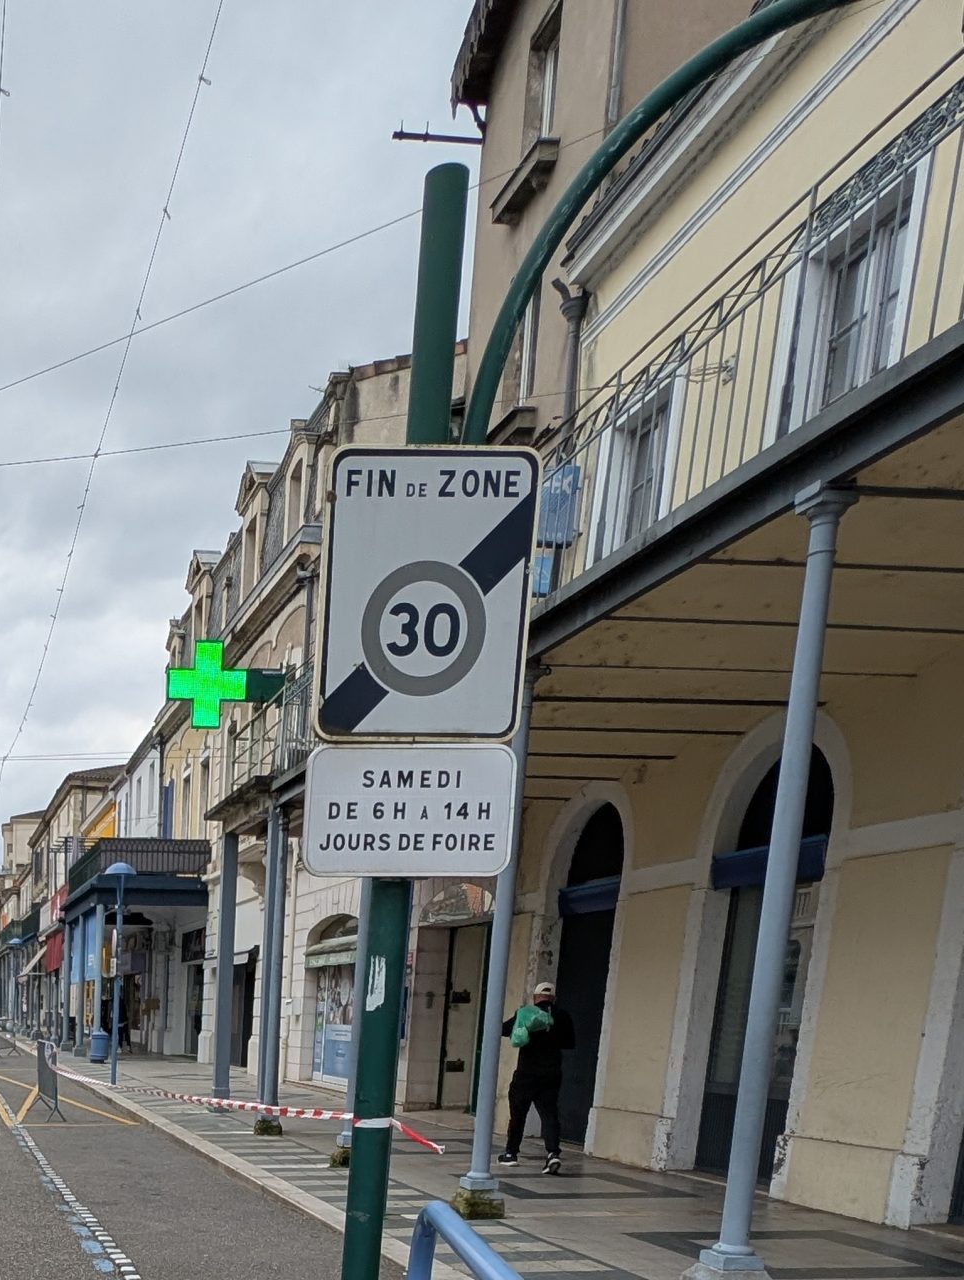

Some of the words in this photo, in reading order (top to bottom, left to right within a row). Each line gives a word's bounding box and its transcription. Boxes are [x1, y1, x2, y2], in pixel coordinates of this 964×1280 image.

[345, 469, 397, 498] FIN
[405, 482, 428, 498] DE
[438, 469, 522, 498] ZONE
[386, 602, 461, 658] 30
[362, 770, 462, 789] SAMEDI
[327, 801, 359, 820] DE
[319, 833, 391, 852] JOURS
[397, 833, 426, 852] DE
[431, 833, 496, 852] FOIRE
